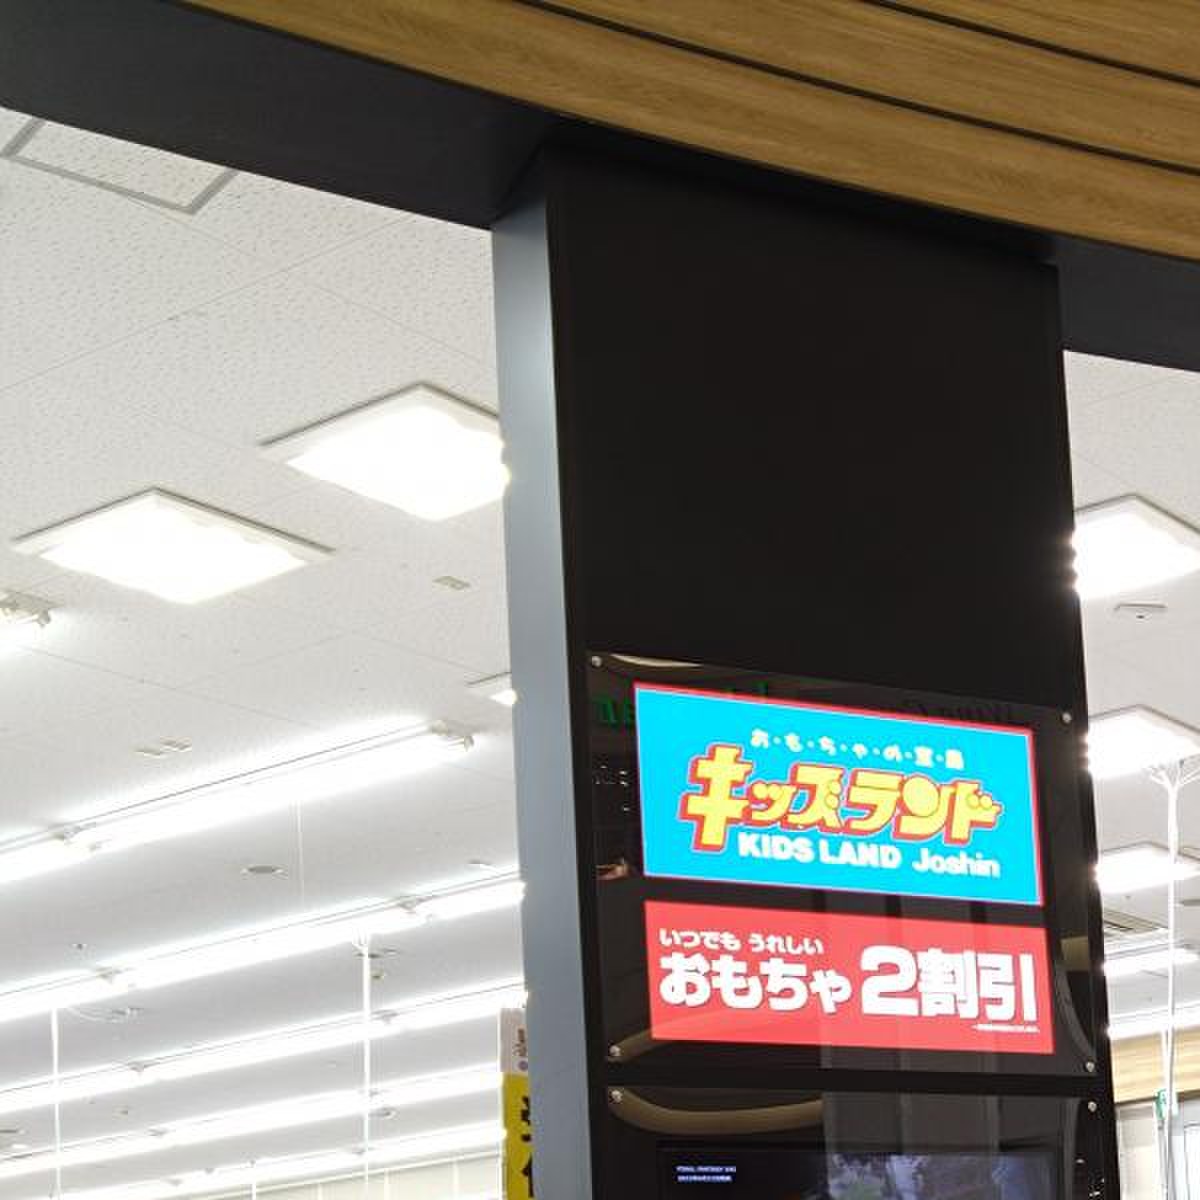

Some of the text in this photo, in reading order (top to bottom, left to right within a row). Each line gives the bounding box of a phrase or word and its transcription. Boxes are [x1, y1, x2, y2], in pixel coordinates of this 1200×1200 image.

[679, 742, 1004, 852] キッズランド
[738, 832, 1001, 878] KIDS LAND Joshin
[658, 927, 824, 956] いつでも うれしい
[658, 943, 1038, 1024] おもちゃ 2割引
